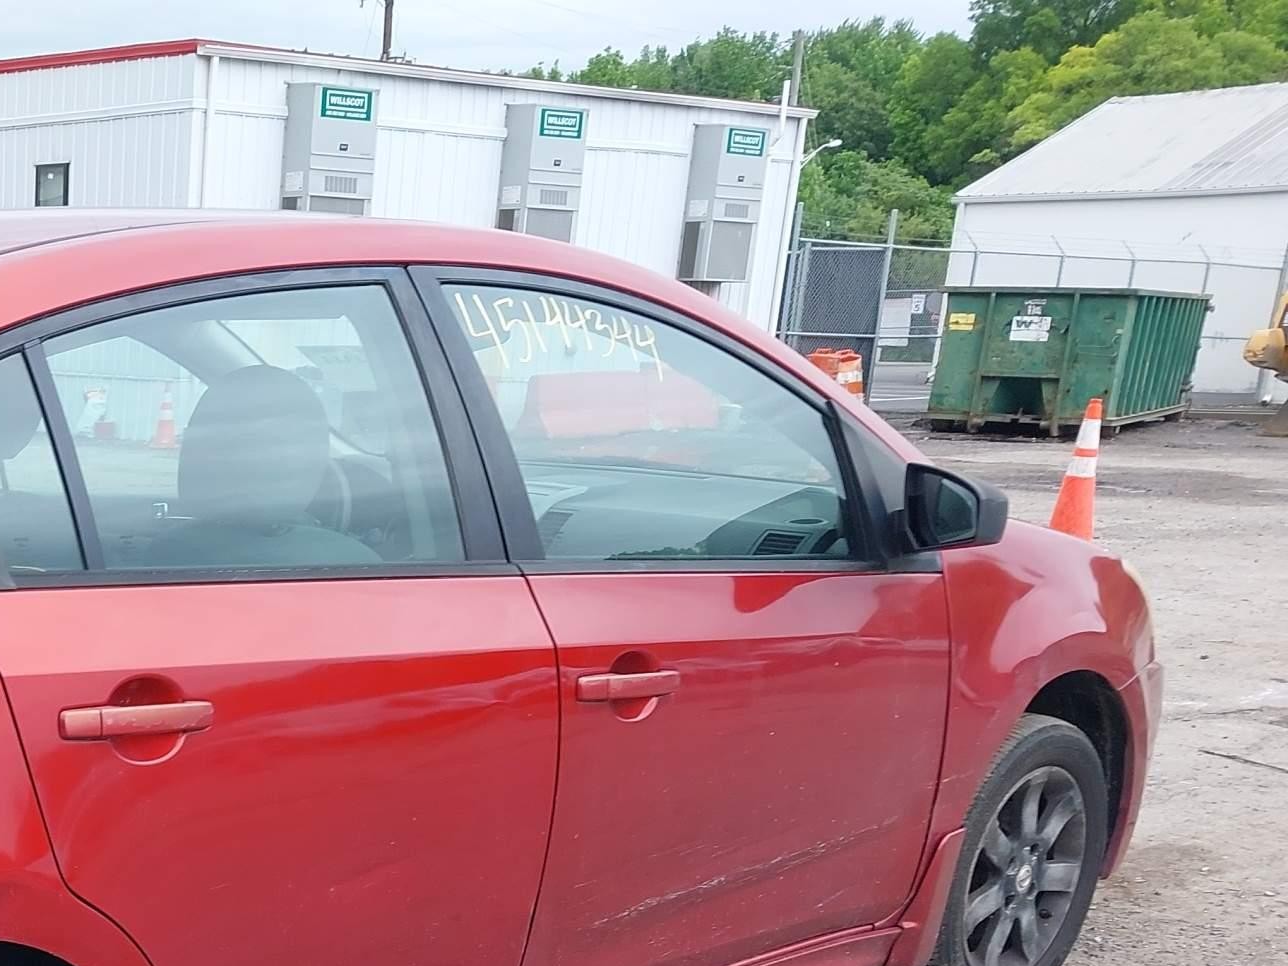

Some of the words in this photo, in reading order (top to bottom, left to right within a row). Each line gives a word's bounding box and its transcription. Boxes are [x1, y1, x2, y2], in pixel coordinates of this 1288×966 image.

[330, 95, 365, 107] WILLSCOT
[547, 116, 577, 126] WILLSCOT
[454, 292, 664, 382] 45144344
